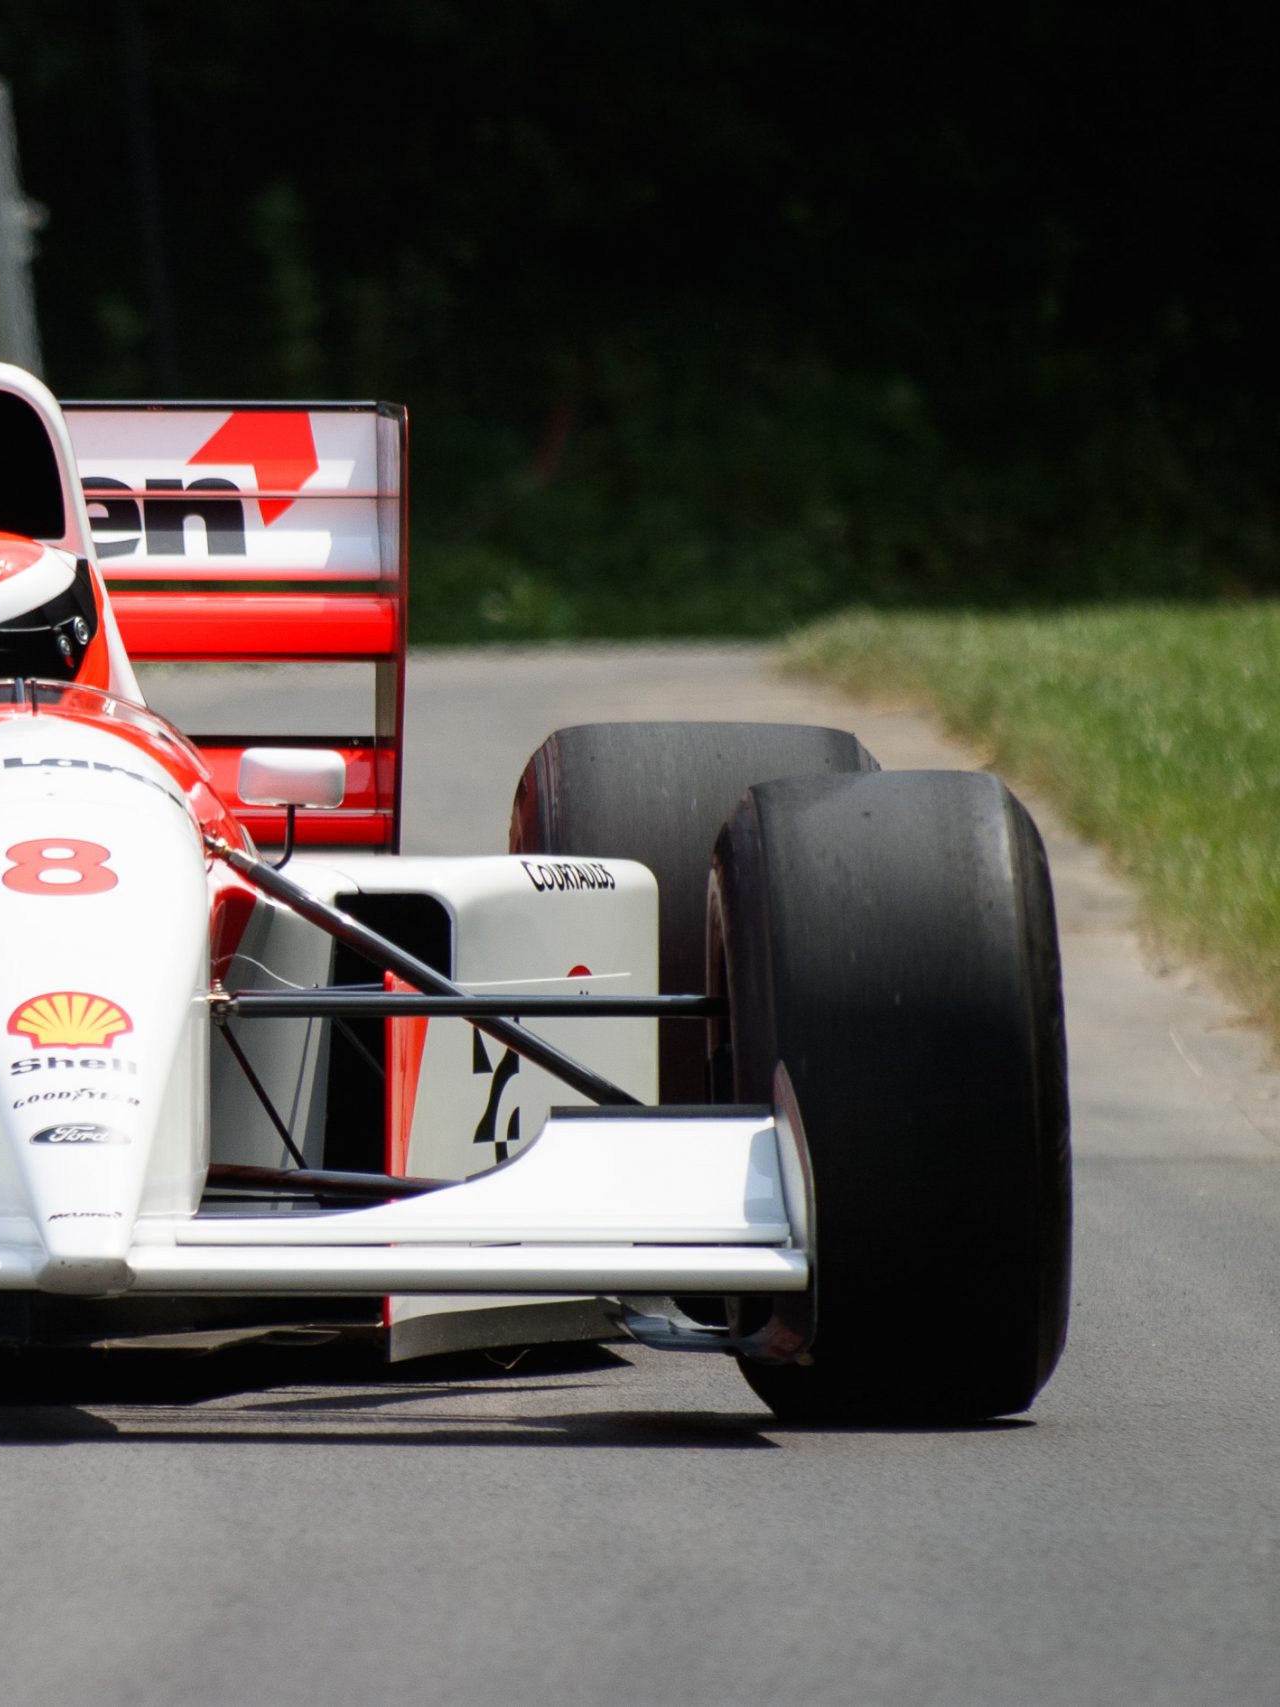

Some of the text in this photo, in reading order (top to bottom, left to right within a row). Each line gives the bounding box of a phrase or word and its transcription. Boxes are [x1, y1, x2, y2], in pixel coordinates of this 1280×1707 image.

[1, 838, 119, 896] 8
[520, 860, 615, 892] COURTAULDS
[10, 1056, 138, 1076] Shell
[12, 1087, 141, 1110] GOODYER
[49, 1126, 111, 1142] Ford
